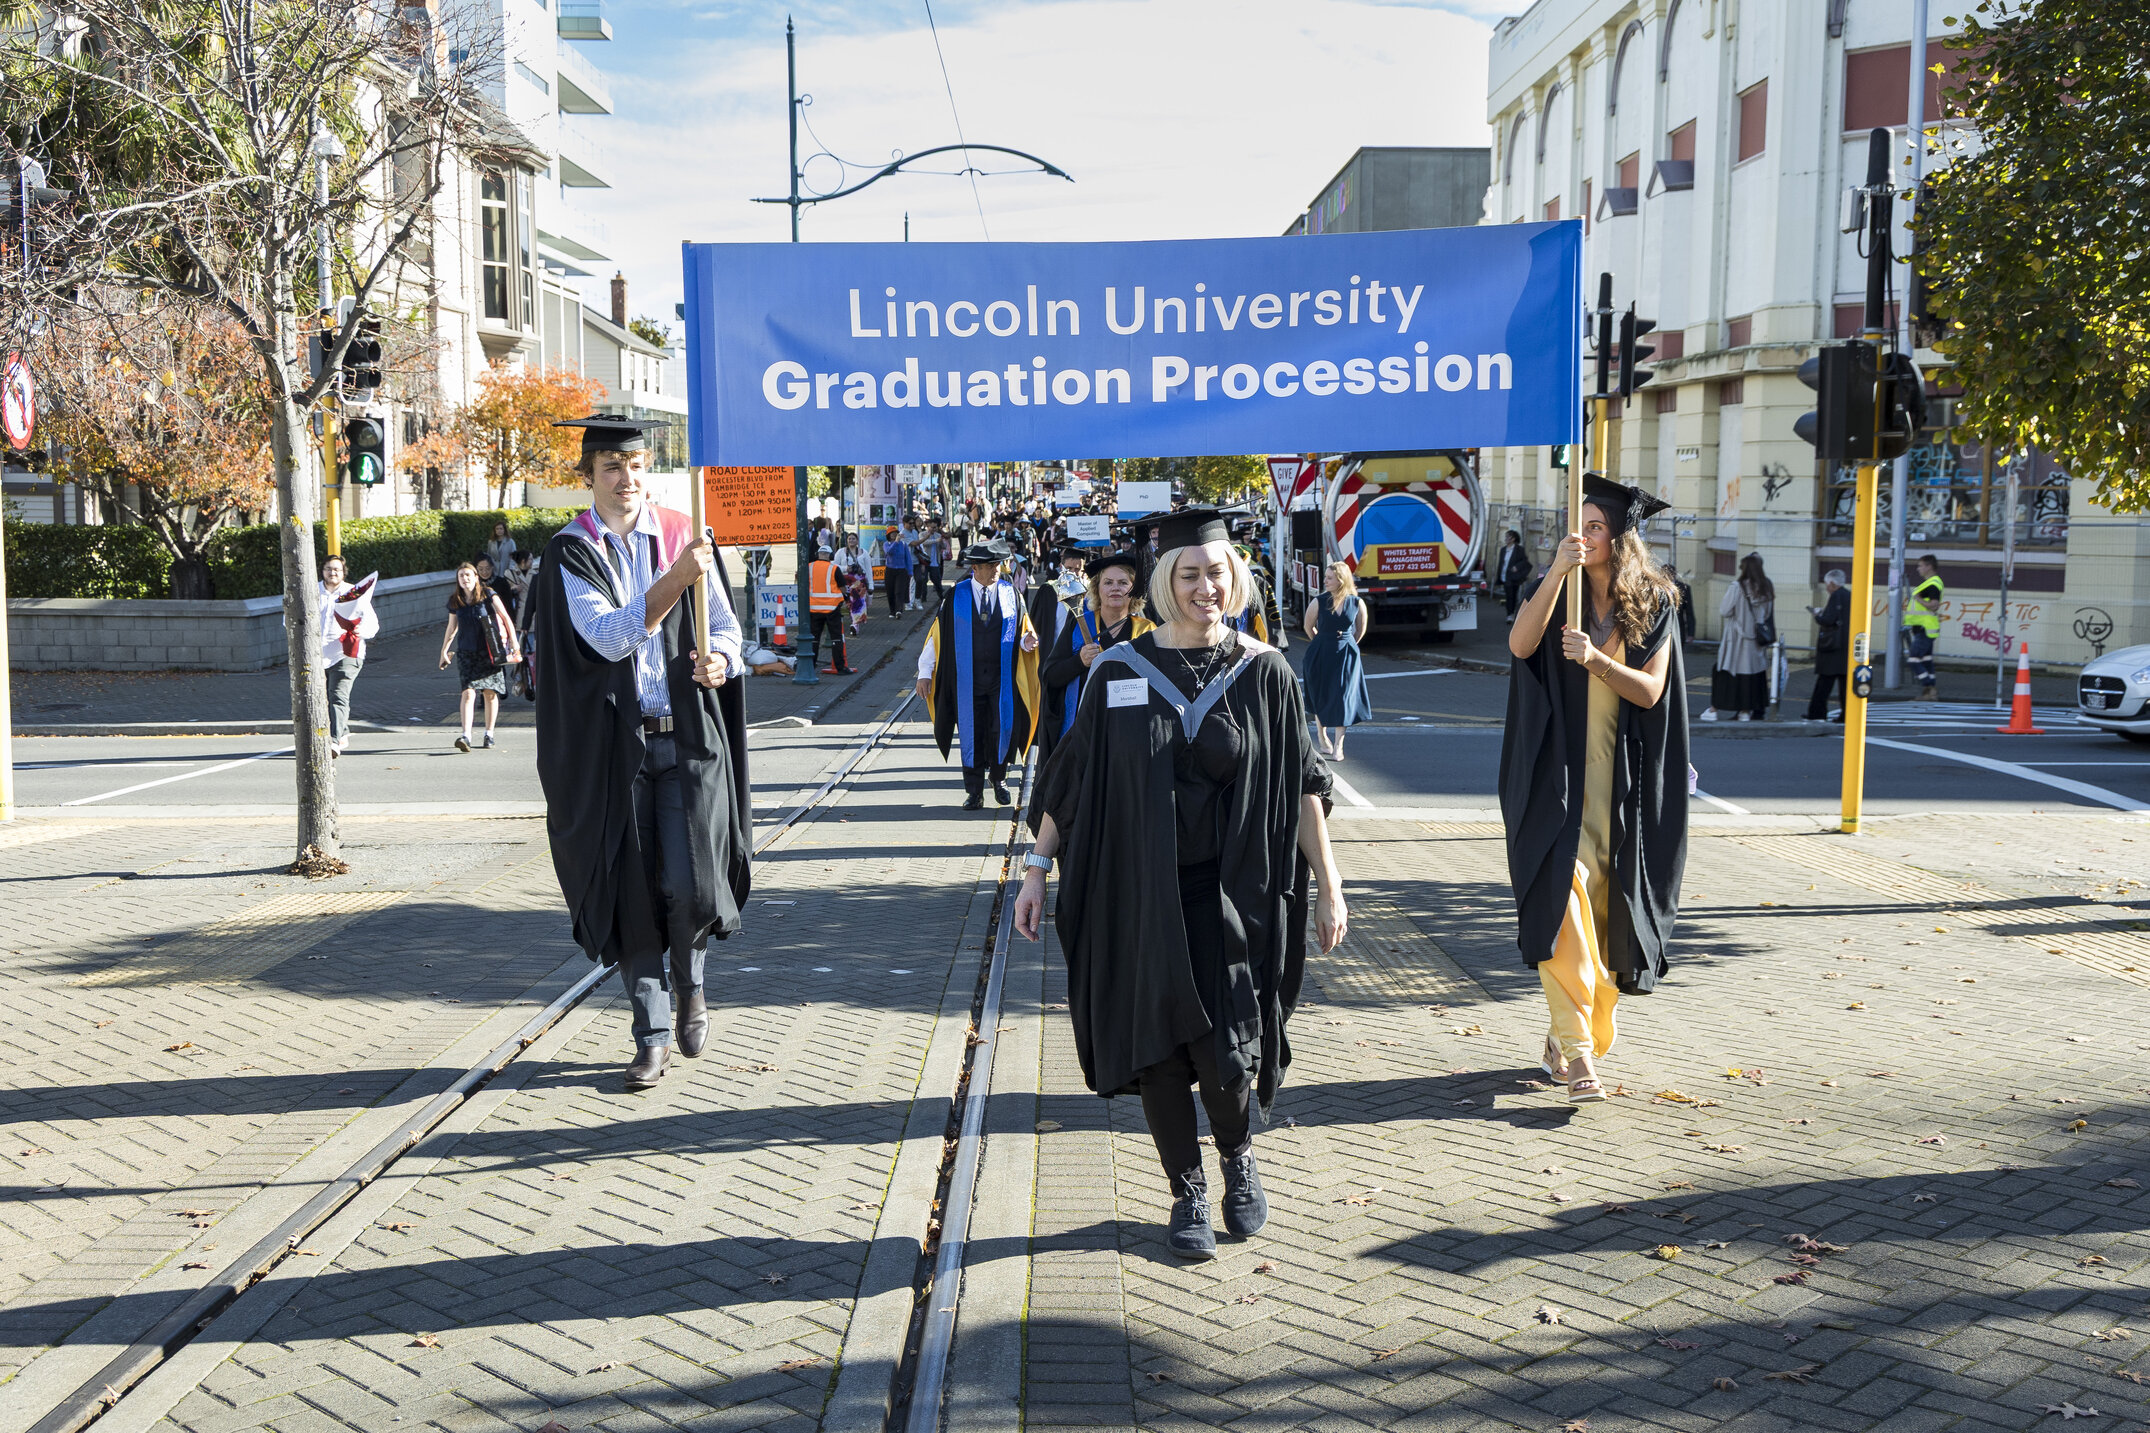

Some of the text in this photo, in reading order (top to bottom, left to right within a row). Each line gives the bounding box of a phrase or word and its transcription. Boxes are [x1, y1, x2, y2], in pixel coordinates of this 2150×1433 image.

[850, 275, 1425, 338] Lincoln University
[763, 341, 1512, 411] Graduation Procession
[710, 466, 788, 476] ROAD CLOSURE
[1278, 467, 1293, 480] GIVE
[706, 476, 745, 485] WORCESTER
[746, 474, 764, 482] BLVD
[710, 484, 750, 492] CAMBRIDGE
[1408, 548, 1433, 556] TRAFFIC
[1386, 556, 1430, 564] MANAGEMENT
[761, 592, 798, 603] Woce
